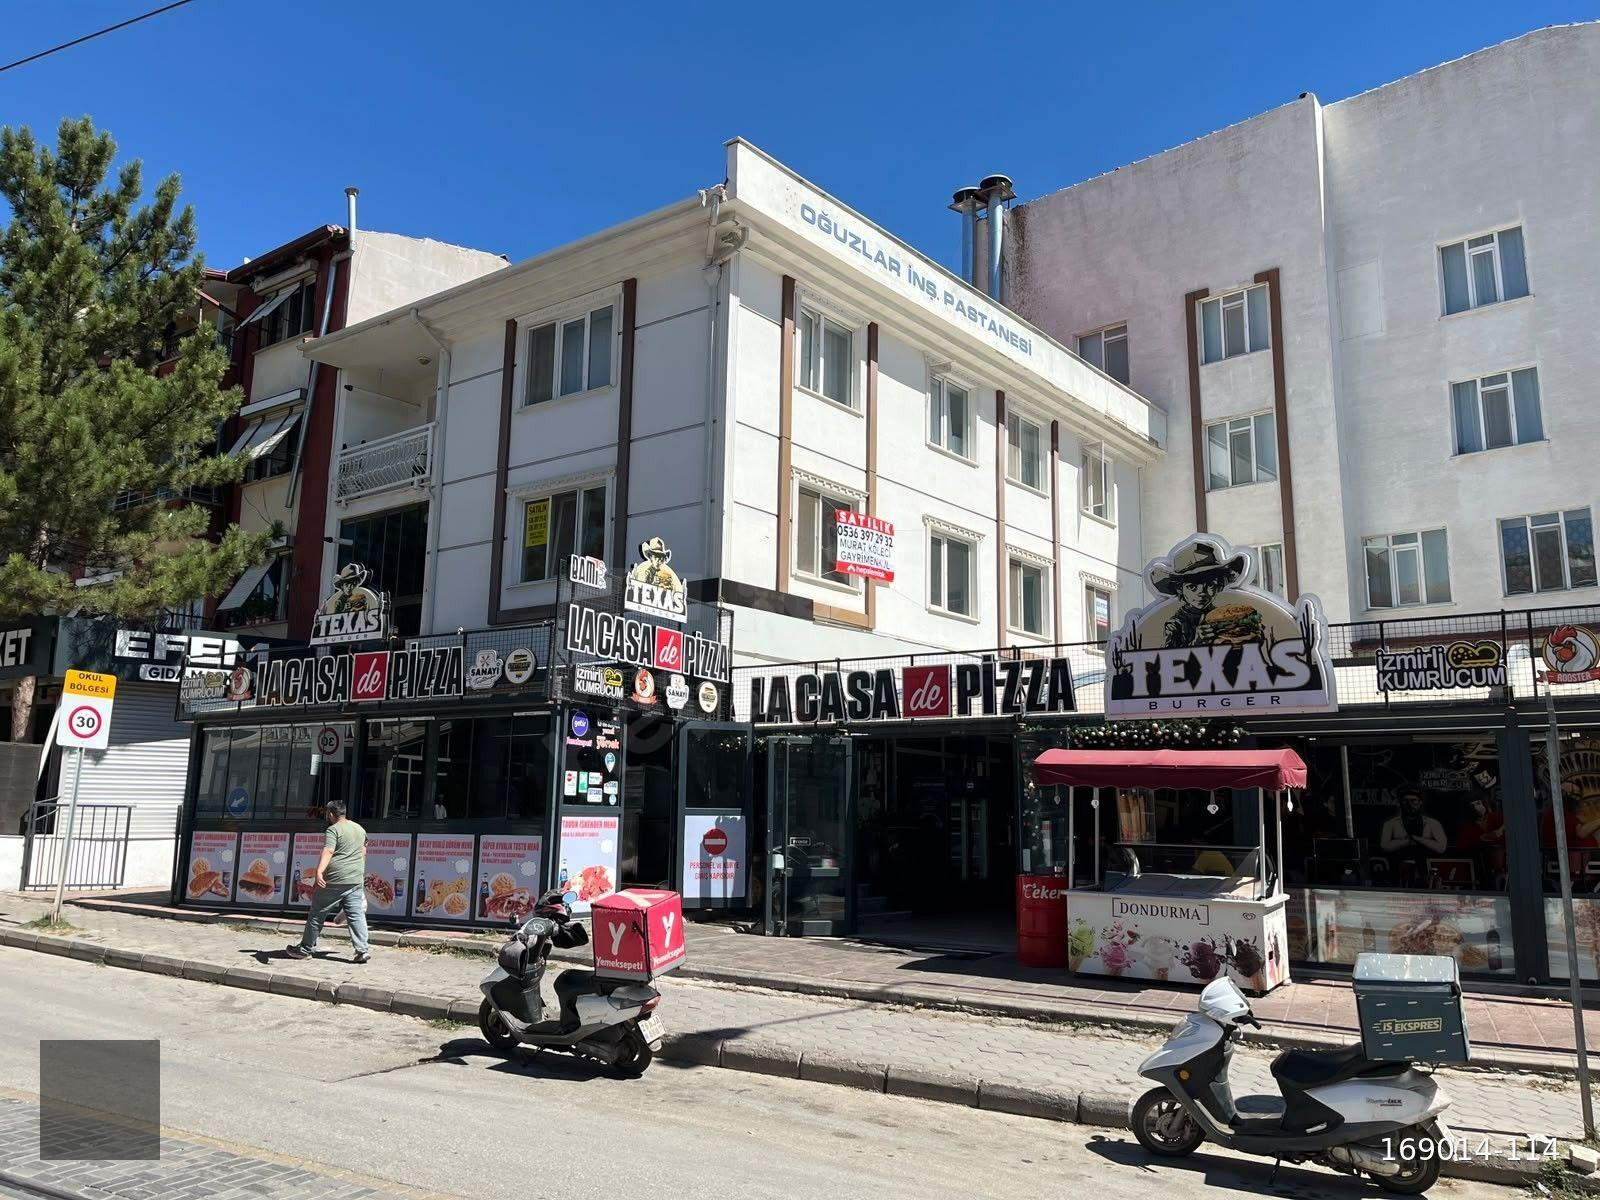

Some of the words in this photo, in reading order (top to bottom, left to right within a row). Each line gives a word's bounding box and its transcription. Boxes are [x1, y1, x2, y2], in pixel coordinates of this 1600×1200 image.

[800, 203, 901, 277] OĞUZLAR
[943, 290, 1032, 356] PASTANESİ
[839, 511, 891, 535] SATILIK
[837, 525, 859, 538] 0536
[860, 529, 874, 542] 397
[875, 533, 884, 544] 29
[885, 536, 894, 548] 32
[840, 538, 867, 551] MURAT
[630, 579, 685, 614] TEXAS
[318, 610, 380, 636] TEXAS
[659, 634, 679, 665] de
[683, 631, 731, 683] PİZZA
[1122, 638, 1311, 697] TEXAS
[78, 672, 103, 682] OKUL
[357, 658, 382, 694] de
[390, 642, 464, 699] PİZZA
[1378, 666, 1507, 691] KUMRUCUM
[1556, 671, 1592, 682] ROOSTER
[69, 682, 109, 694] BÖLGESİ
[575, 681, 624, 699] KUMRUCUM
[909, 671, 944, 712] de
[956, 654, 1079, 716] PİZZA
[1149, 695, 1281, 710] BURGER
[76, 716, 95, 729] 30
[1119, 902, 1201, 921] DONDURMA
[596, 956, 643, 971] Yemeksepeti
[1394, 1020, 1440, 1033] EKSPRES
